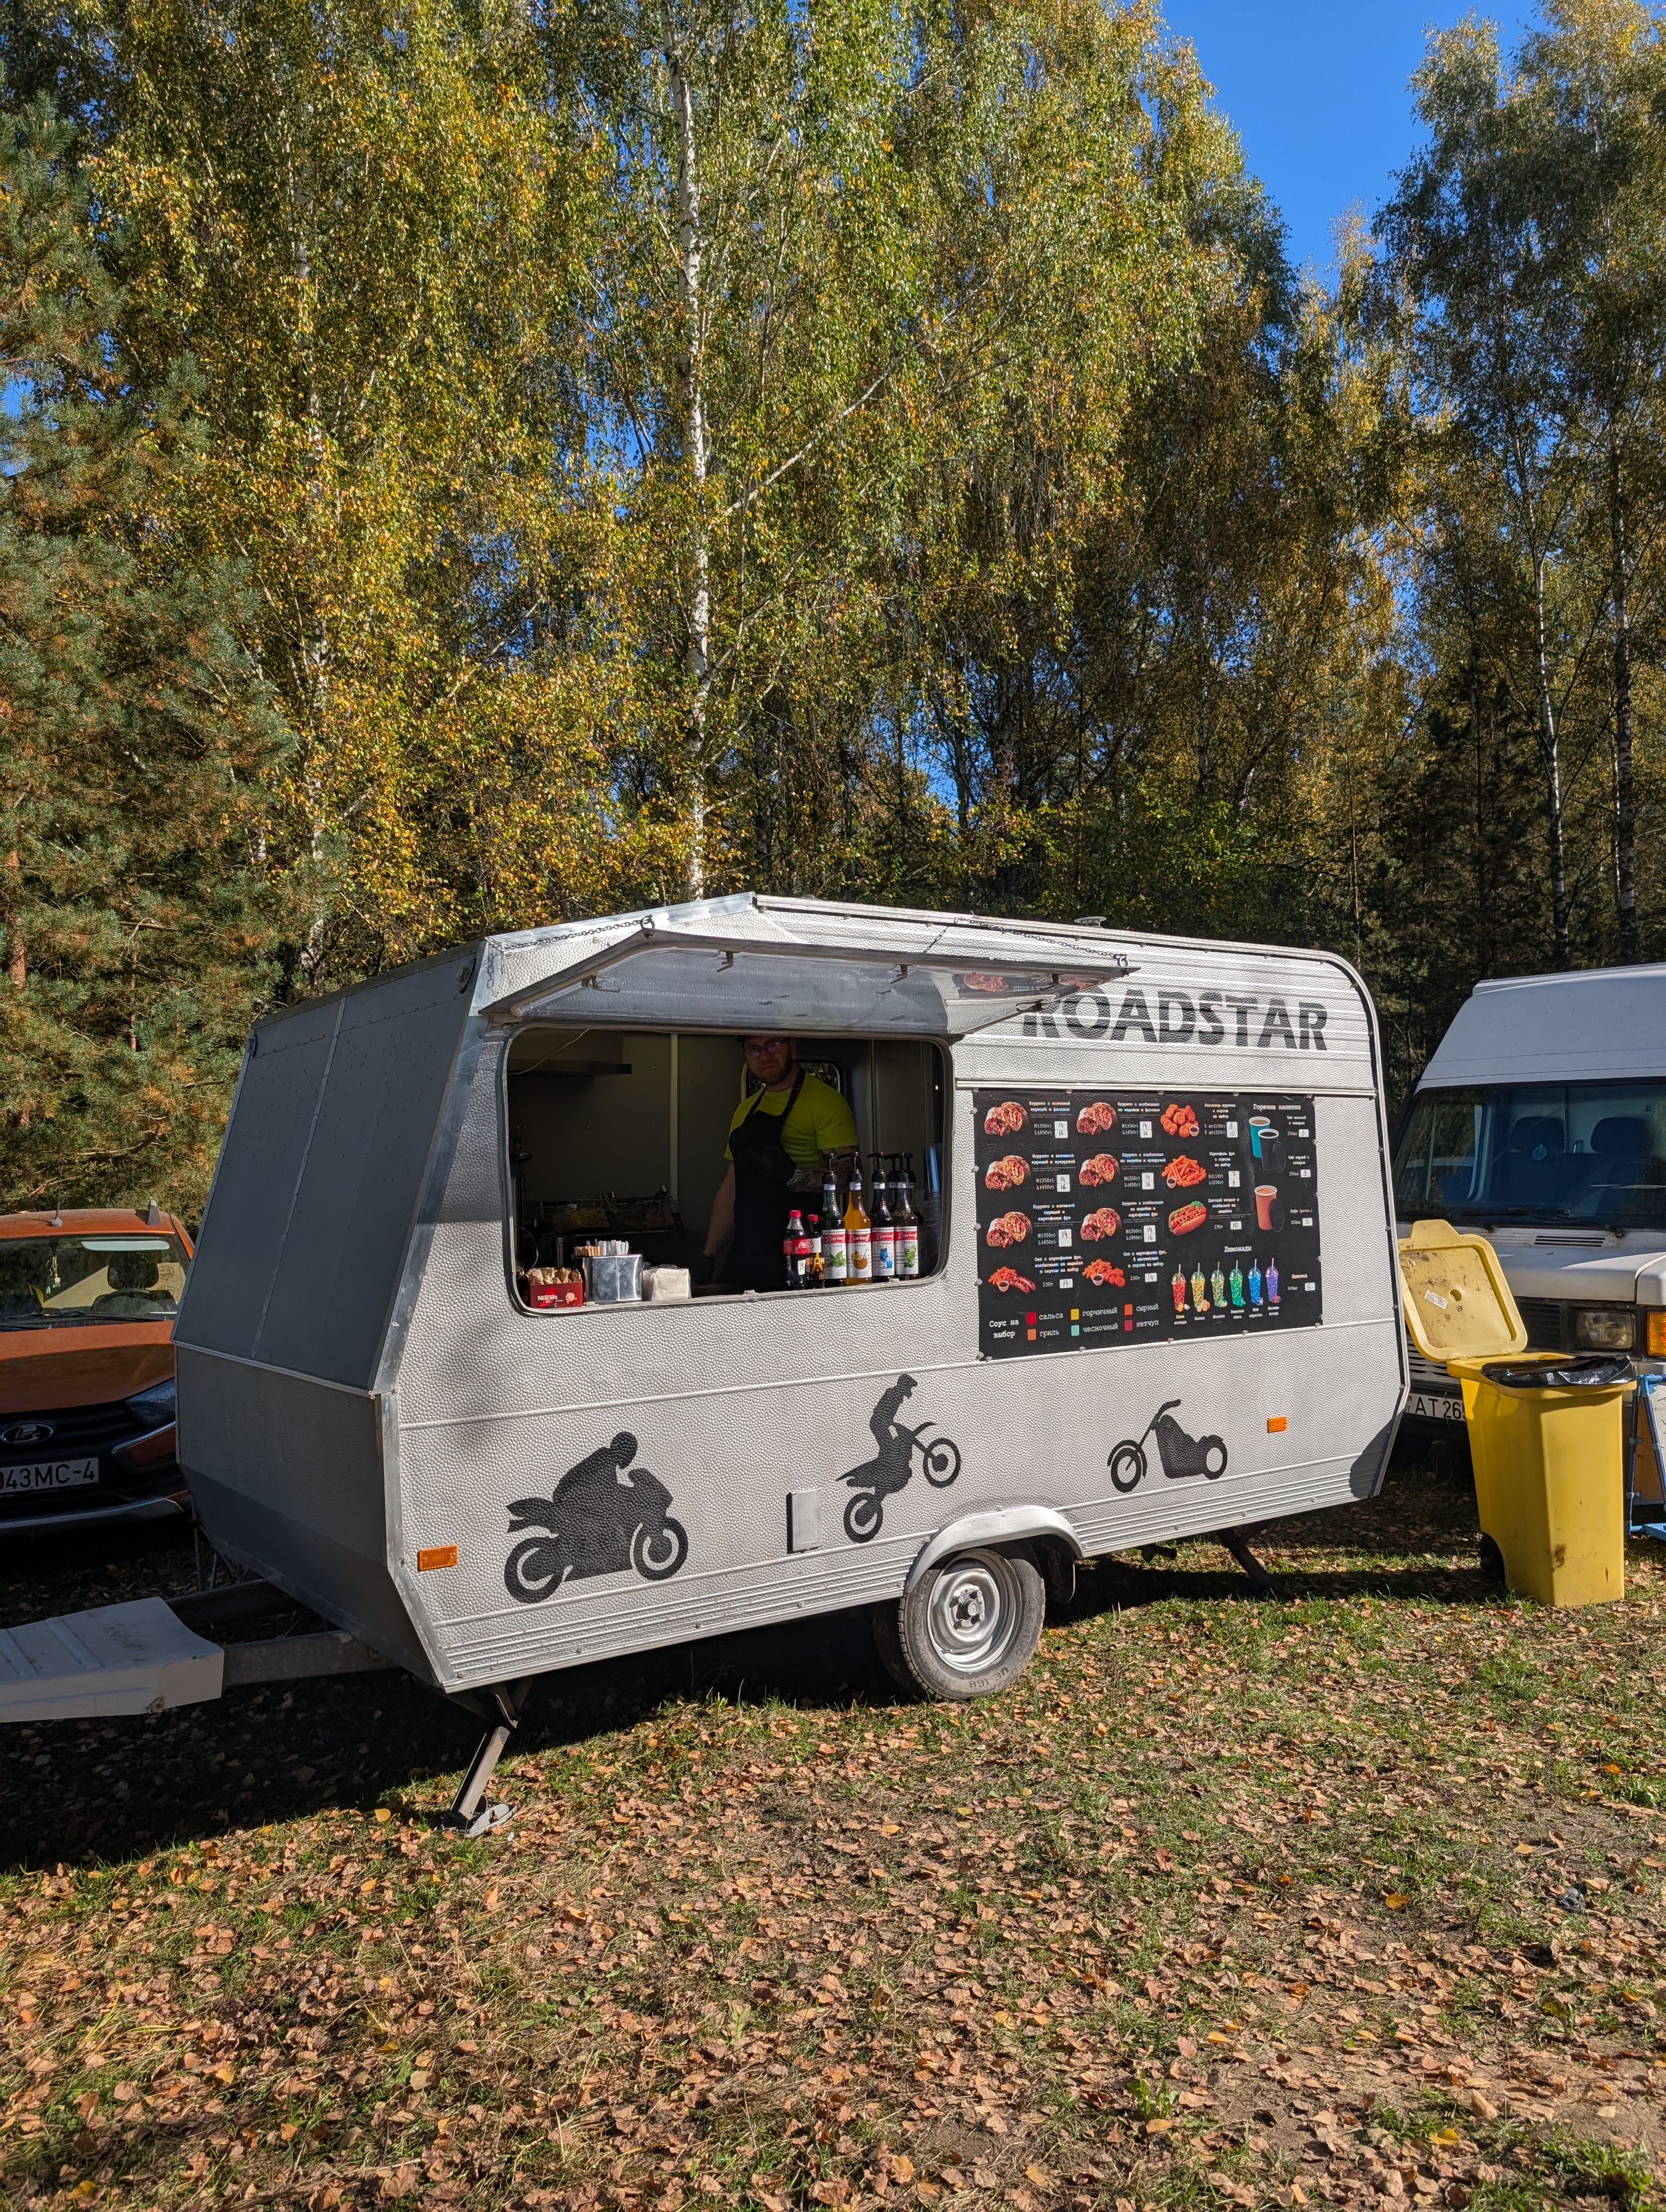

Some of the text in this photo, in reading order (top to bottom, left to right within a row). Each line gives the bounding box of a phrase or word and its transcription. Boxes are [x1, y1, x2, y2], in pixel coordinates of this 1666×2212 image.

[1062, 1230, 1067, 1238] 14
[1082, 1307, 1118, 1317] горчичный
[1136, 1303, 1159, 1312] сырный
[1082, 1322, 1118, 1333] чесночный
[994, 1330, 1015, 1339] выбор
